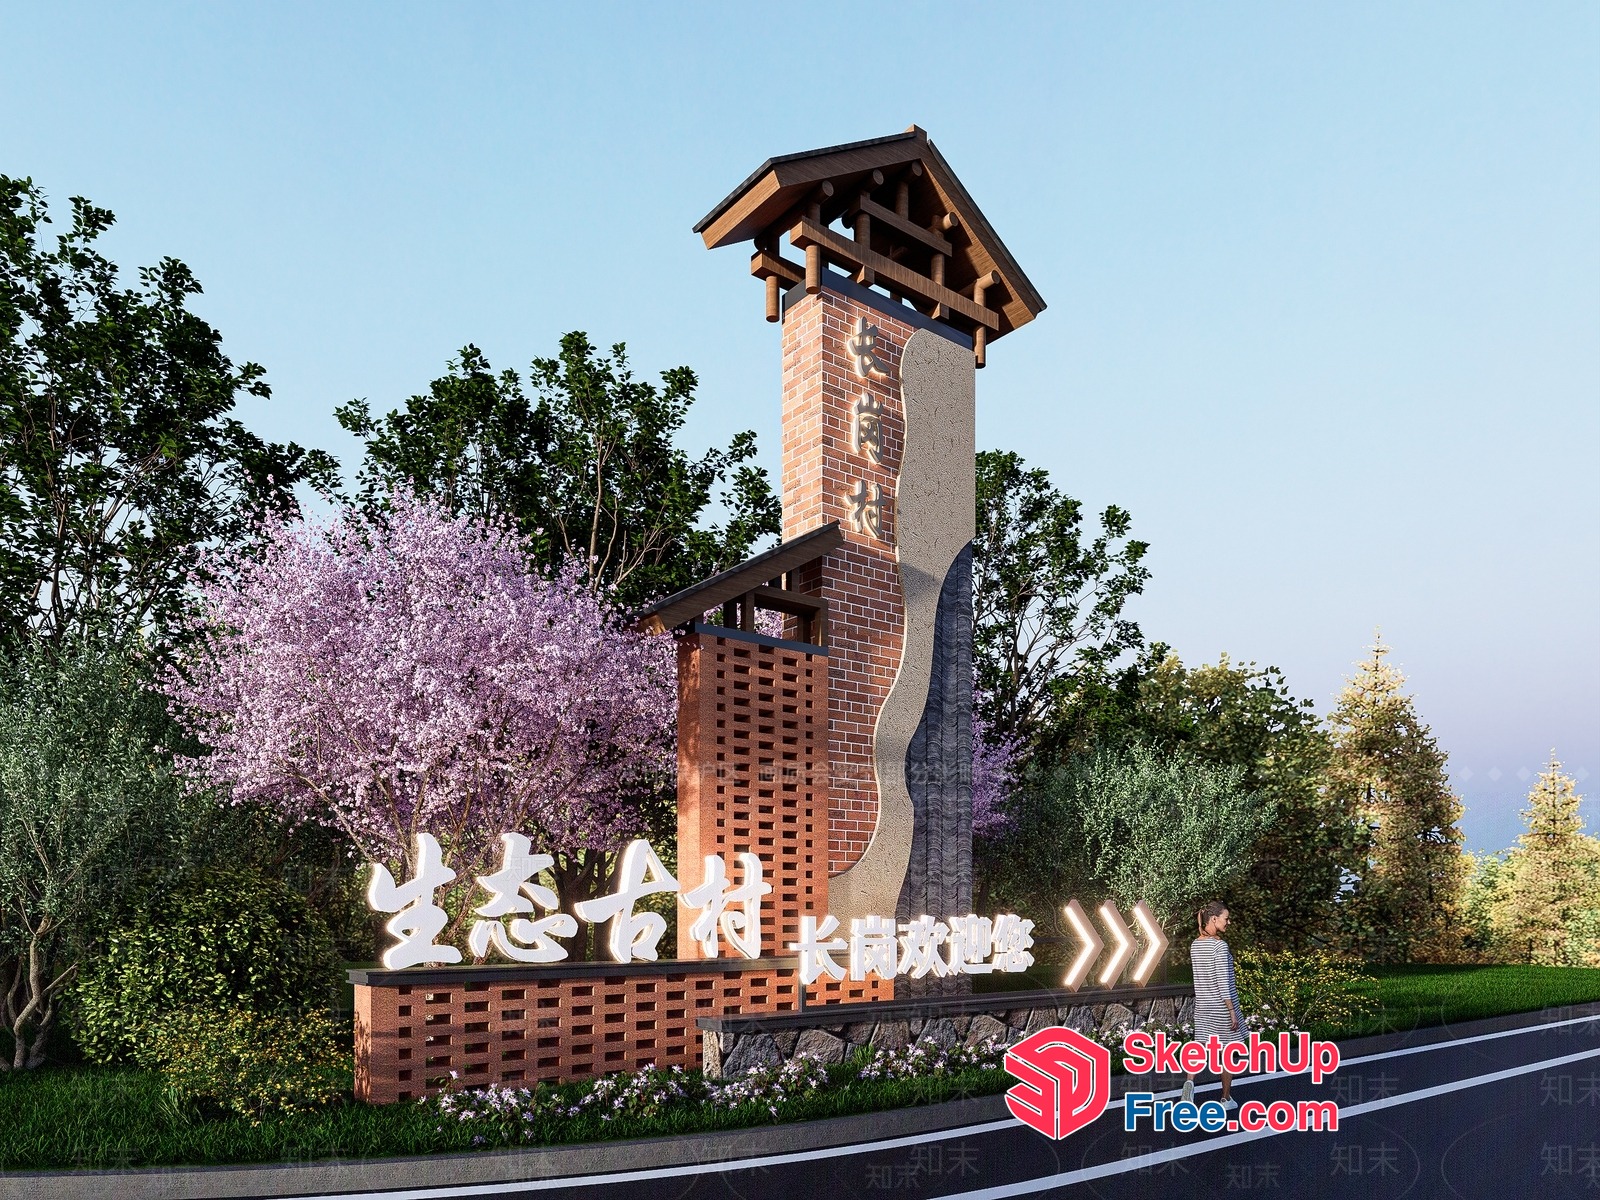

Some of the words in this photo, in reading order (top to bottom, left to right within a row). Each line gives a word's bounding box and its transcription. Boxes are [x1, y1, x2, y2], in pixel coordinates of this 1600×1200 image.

[368, 832, 772, 970] 生态古村
[790, 913, 1036, 985] 长岗欢迎您
